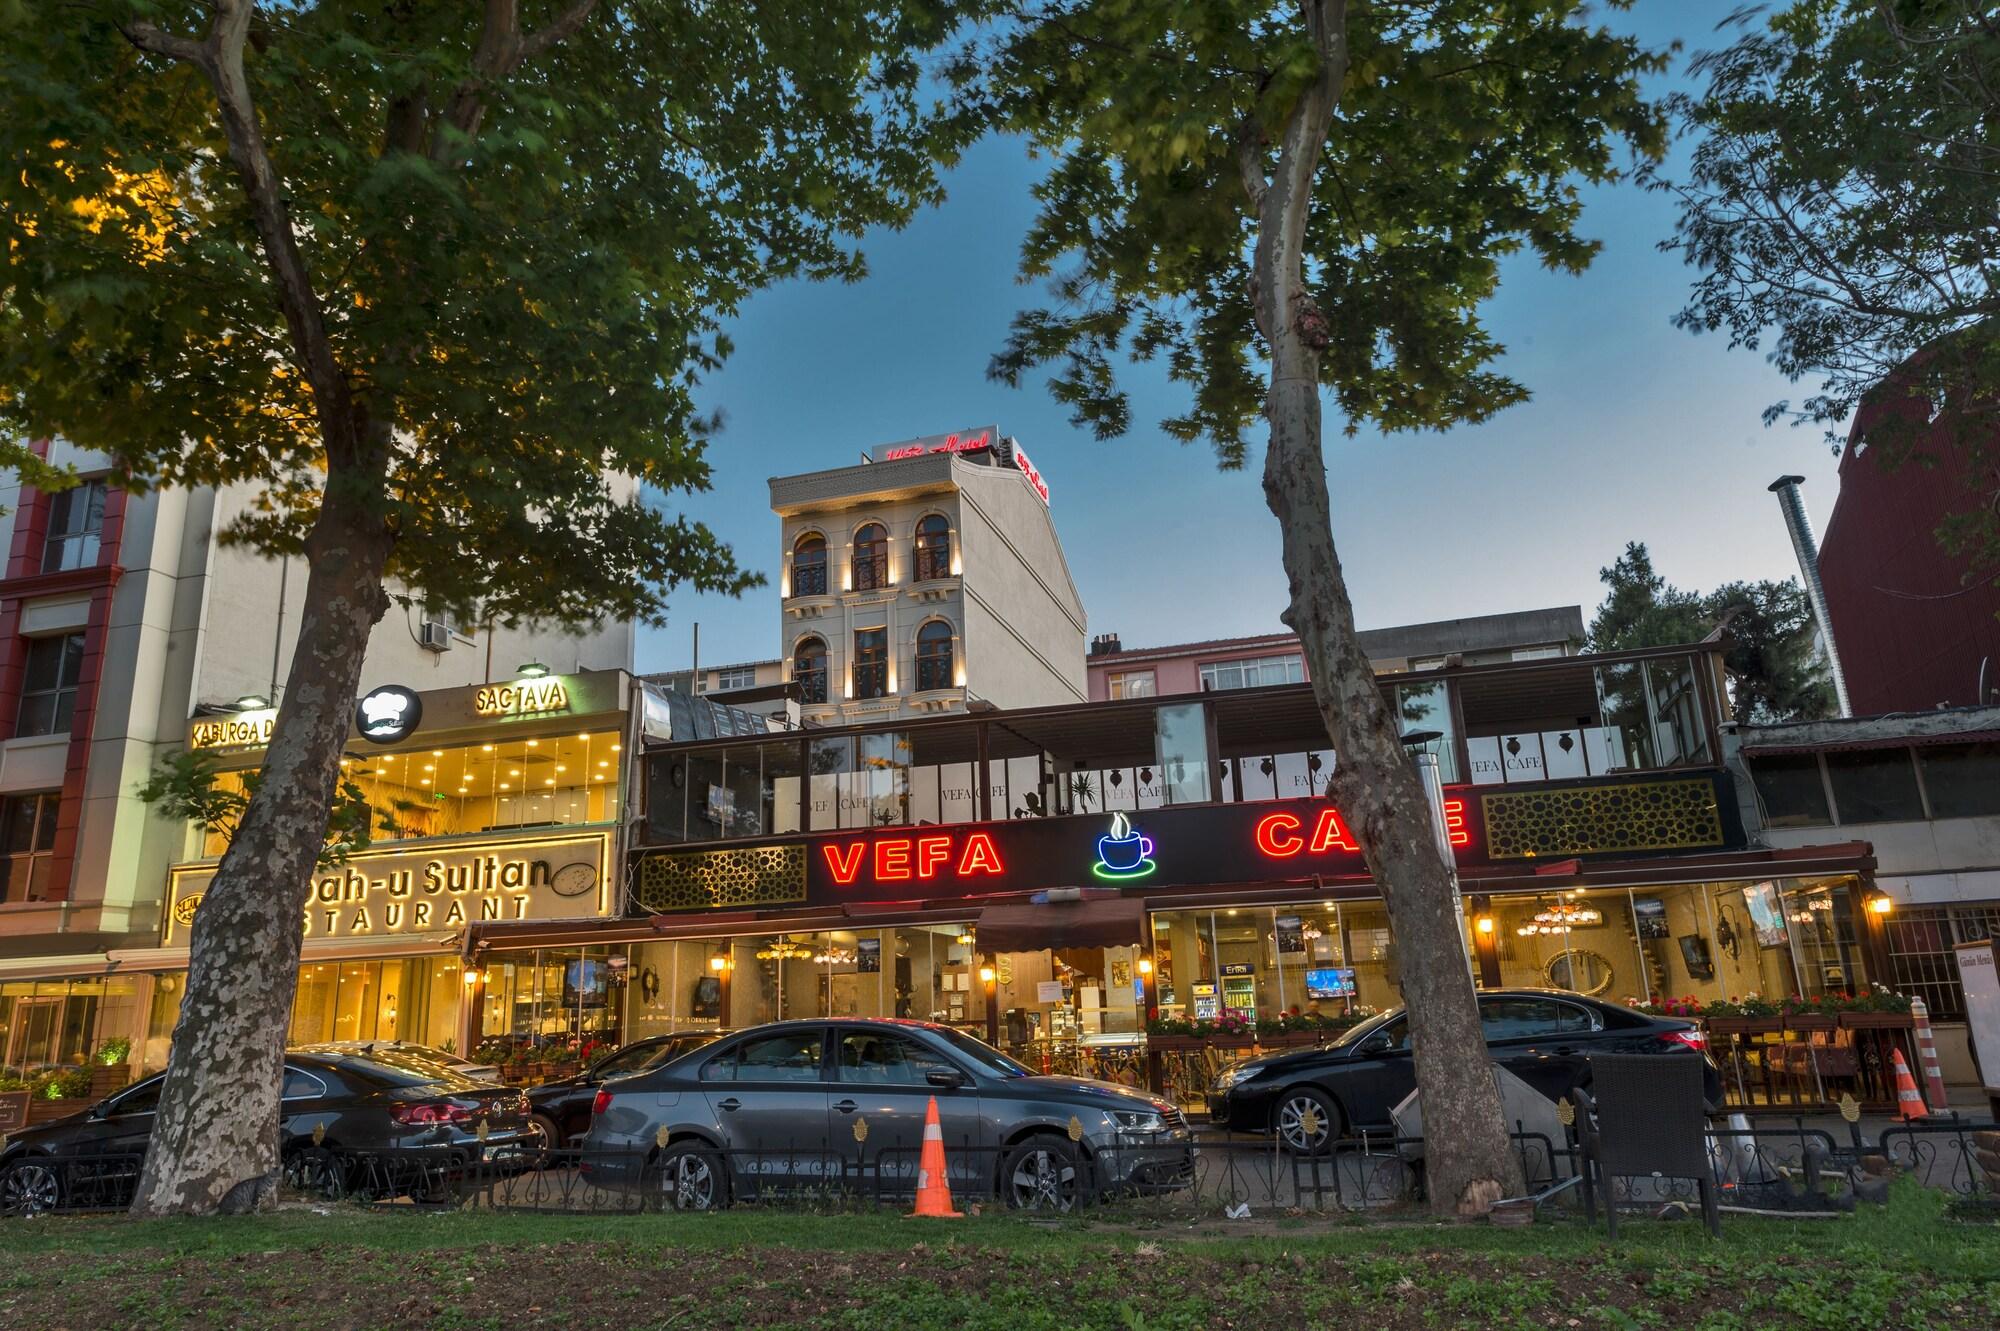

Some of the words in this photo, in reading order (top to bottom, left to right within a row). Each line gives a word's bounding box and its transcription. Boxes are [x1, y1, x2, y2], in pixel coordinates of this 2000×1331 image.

[516, 682, 563, 706] TAVA
[191, 721, 260, 746] KABURGA
[263, 719, 275, 738] D
[1506, 756, 1542, 770] CAFE
[942, 788, 971, 801] VEFA
[823, 834, 1002, 883] VEFA
[1257, 801, 1468, 856] CAE
[422, 856, 551, 894] Sultan
